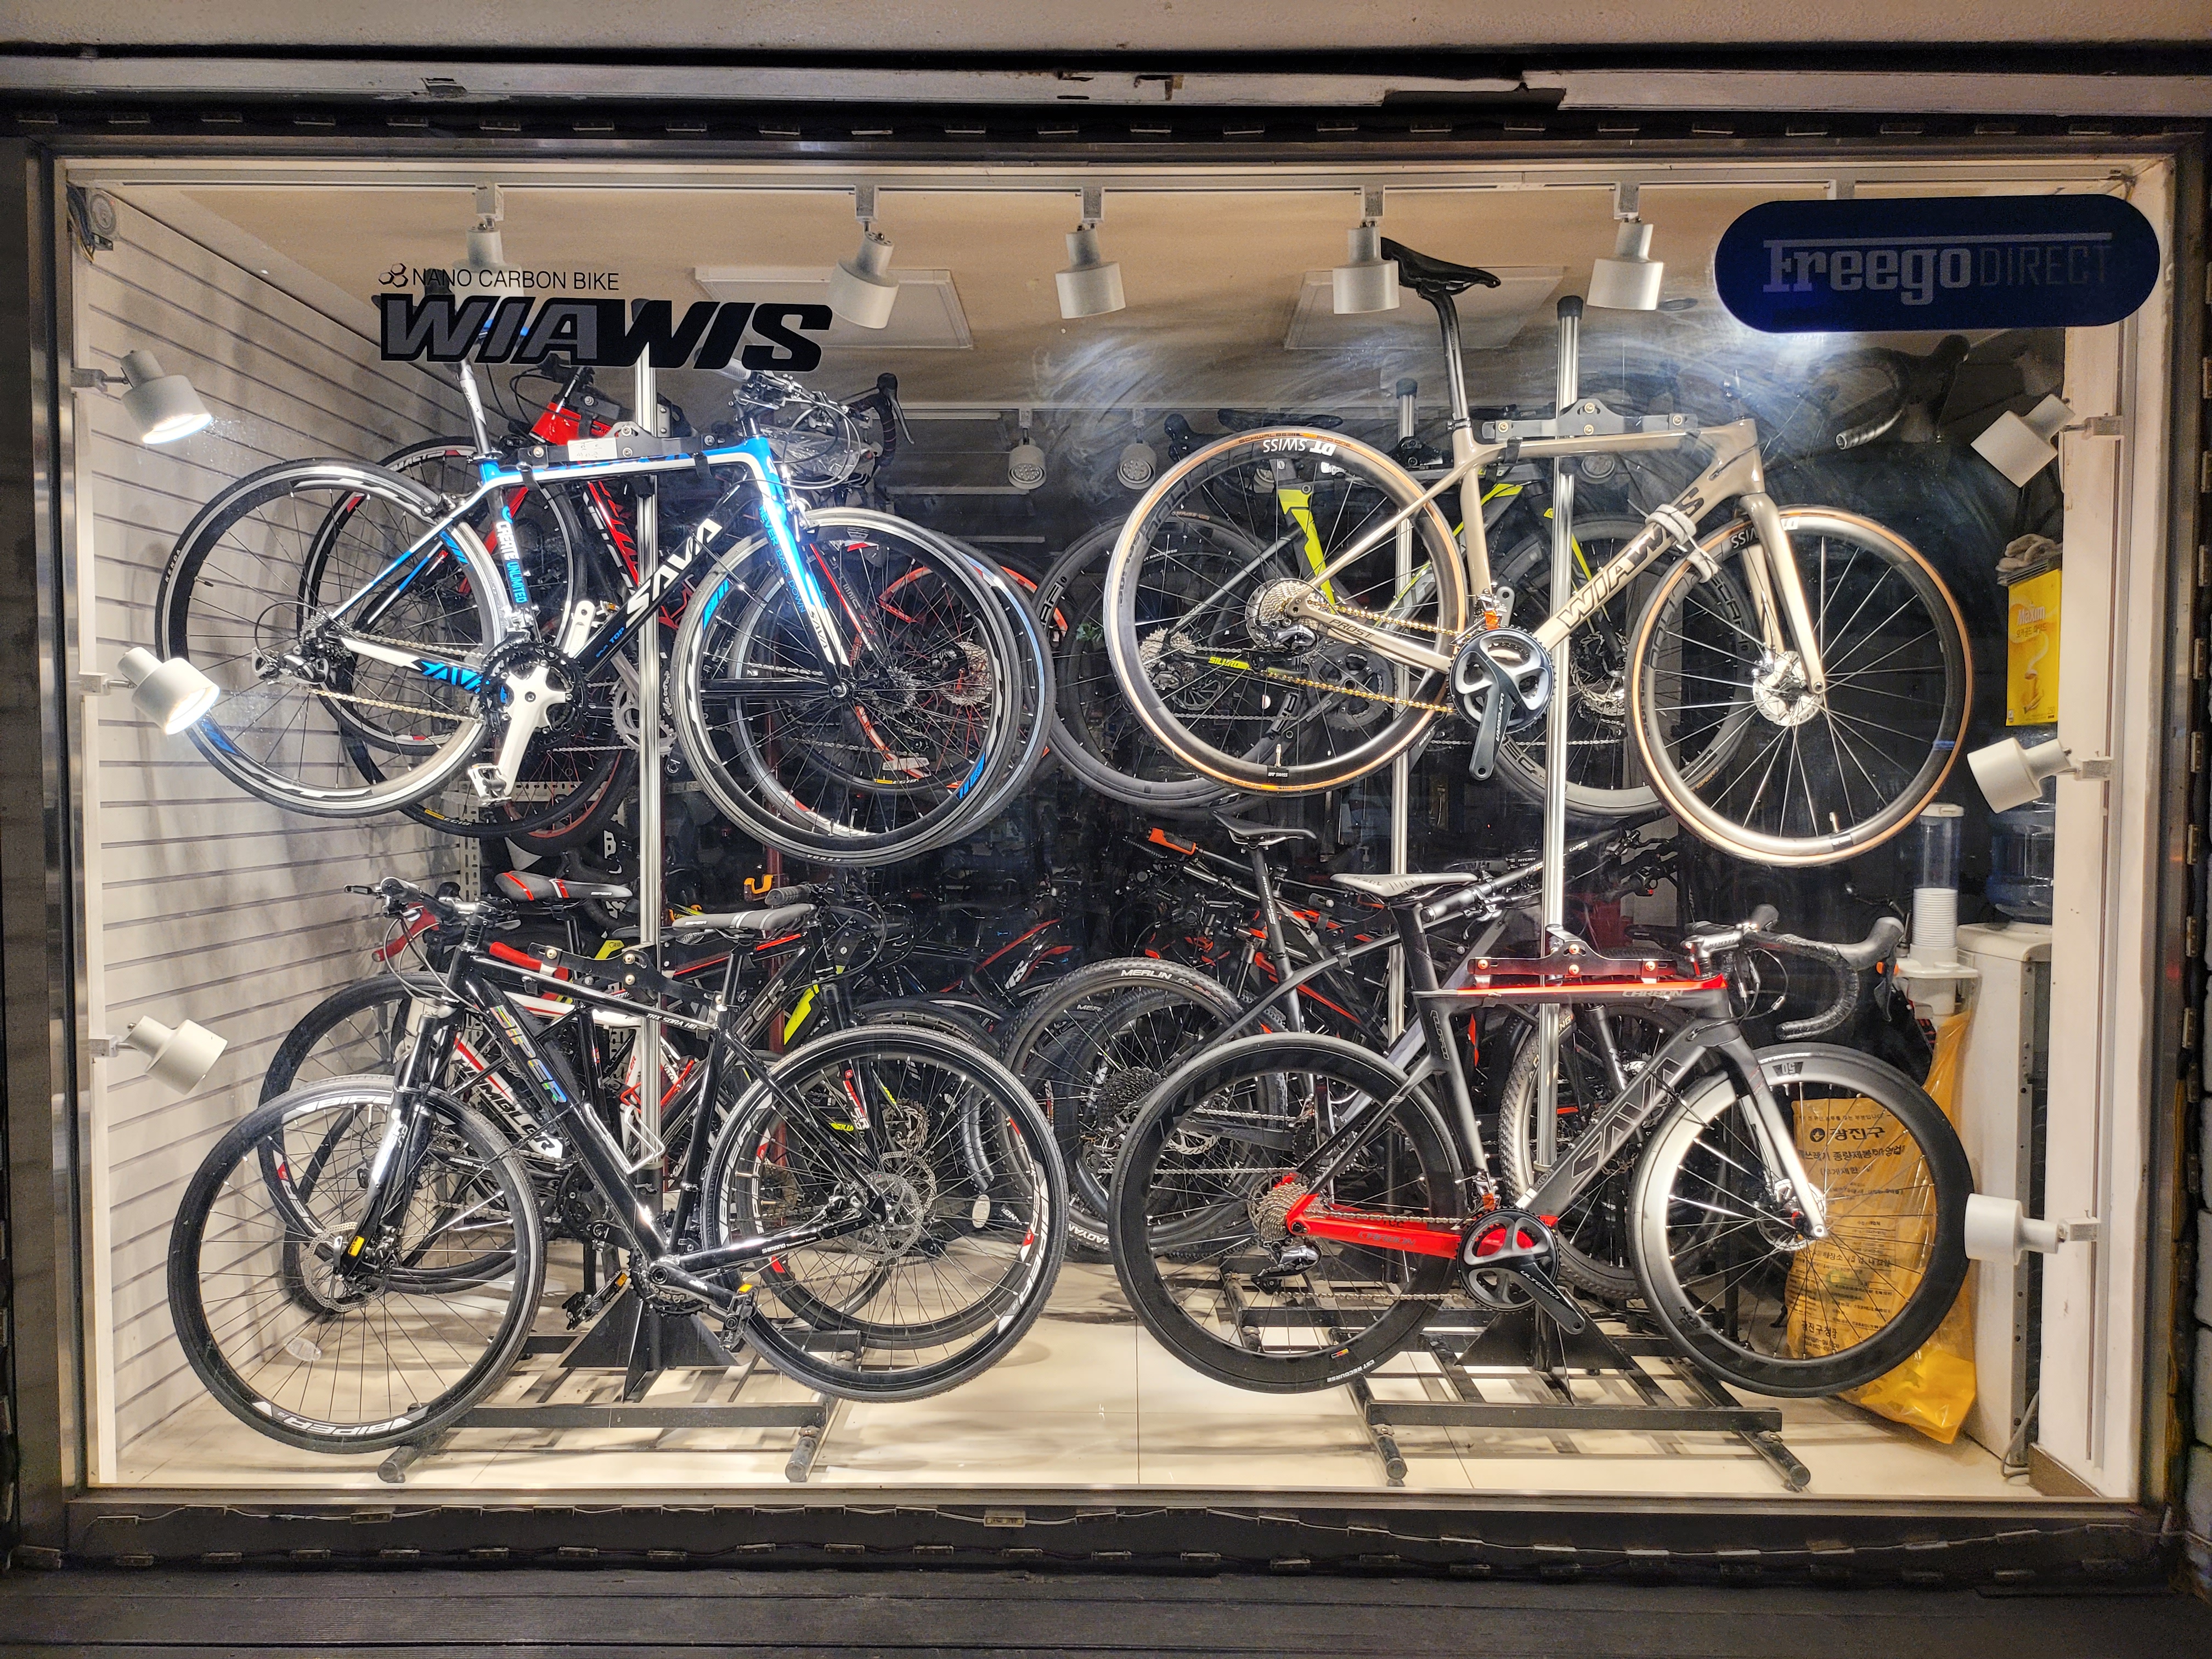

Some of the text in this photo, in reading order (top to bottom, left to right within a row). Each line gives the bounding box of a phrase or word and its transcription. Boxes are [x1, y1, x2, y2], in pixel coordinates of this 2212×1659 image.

[412, 268, 620, 291] NANO CARBON BIKE
[1763, 240, 2112, 306] Freego DIRECT
[380, 292, 833, 372] WIAWIS
[1263, 439, 1338, 456] DT SWISS
[164, 548, 181, 583] KENDA
[495, 520, 527, 604] CREATE UNLIMITED
[759, 504, 806, 614] NEVER BACK DOWN
[1556, 487, 1704, 630] WIAWS
[626, 517, 723, 629] SAVA
[807, 608, 828, 650] SAVA
[2017, 606, 2046, 627] Maxim
[609, 625, 625, 645] TOP
[1496, 692, 1505, 742] ULTEGRA
[806, 853, 841, 863] KENDA
[1120, 969, 1172, 980] MERLIN
[646, 1013, 662, 1021] TRX
[662, 1017, 685, 1027] SORA
[317, 1096, 392, 1110] BIPE
[1570, 1056, 1686, 1196] SAVA
[761, 1243, 786, 1254] SHIMANO
[1519, 1269, 1560, 1300] ULTEGRA
[1326, 1363, 1362, 1384] RECOURSE
[283, 1416, 394, 1437] BIPER
